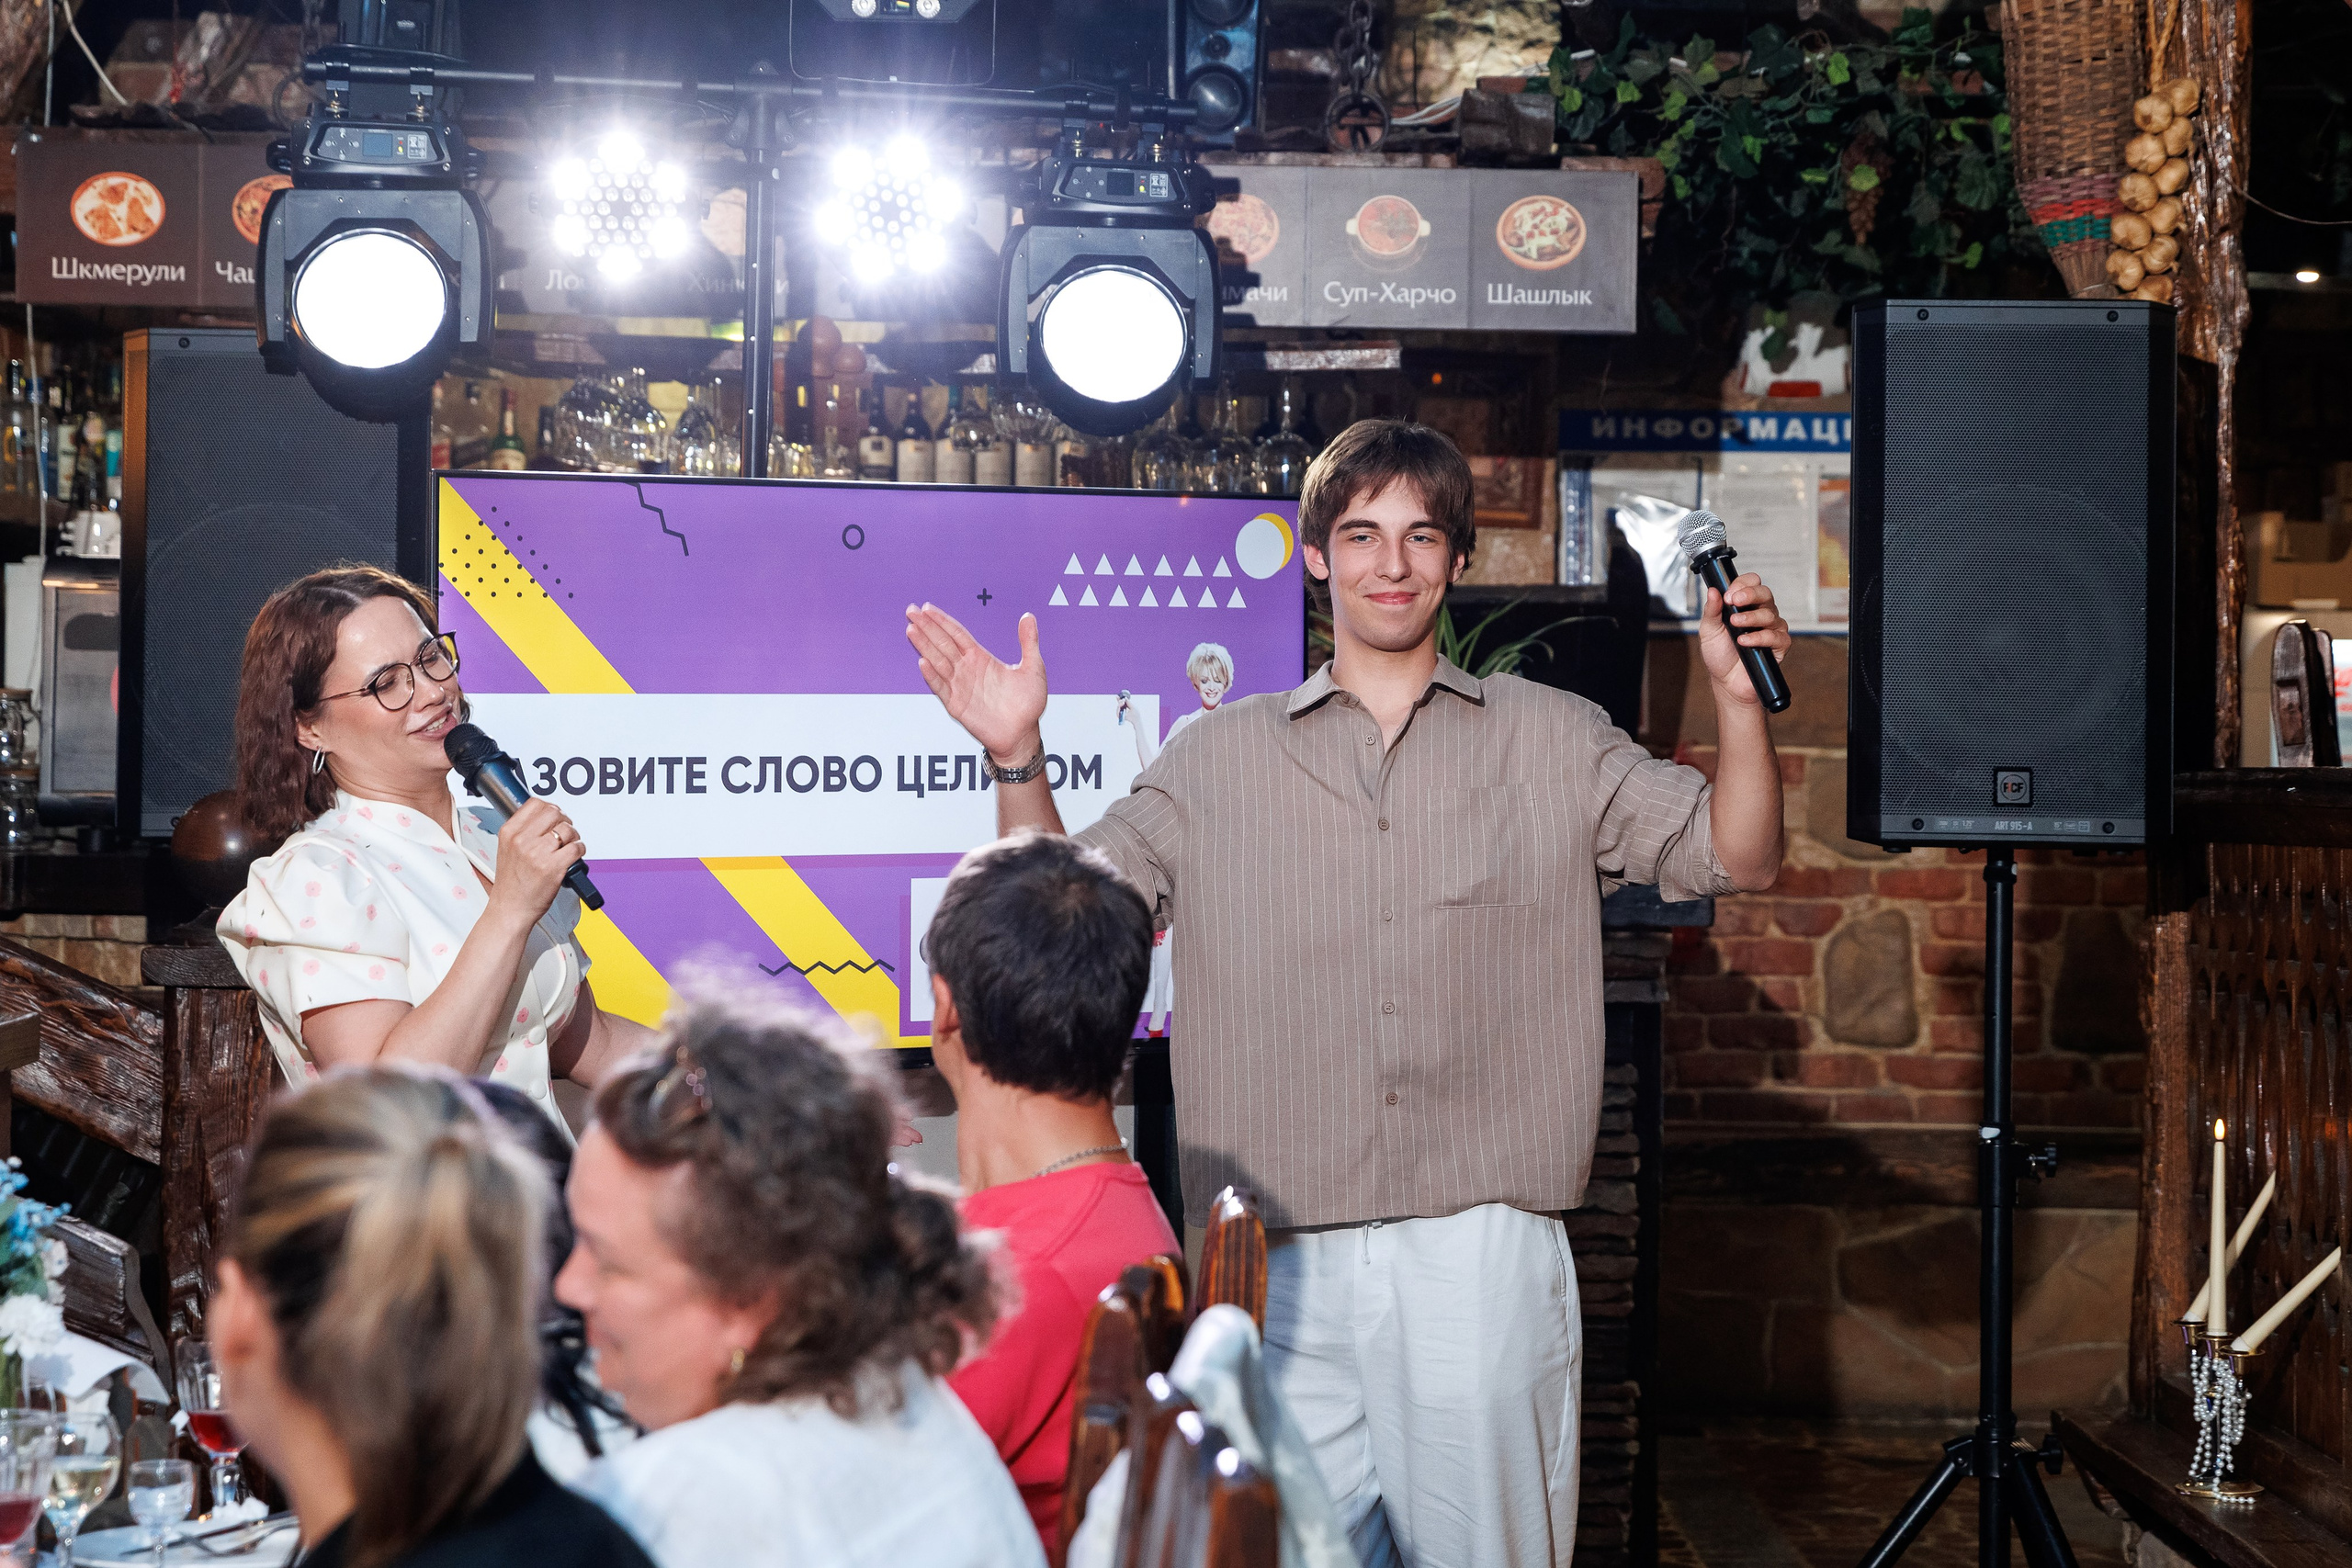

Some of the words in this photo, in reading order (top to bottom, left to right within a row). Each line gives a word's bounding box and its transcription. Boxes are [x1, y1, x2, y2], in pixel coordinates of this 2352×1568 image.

[51, 256, 186, 287] Шкмерули
[1323, 281, 1457, 309] Суп-Харчо
[1487, 283, 1593, 305] Шашлык
[467, 756, 707, 796] ЗОВИТЕ
[720, 754, 883, 795] СЛОВО
[896, 753, 1102, 798] ЦЕЛОМ
[2003, 782, 2024, 794] RCF
[1995, 820, 2008, 831] ART
[2010, 820, 2033, 831] 915-A
